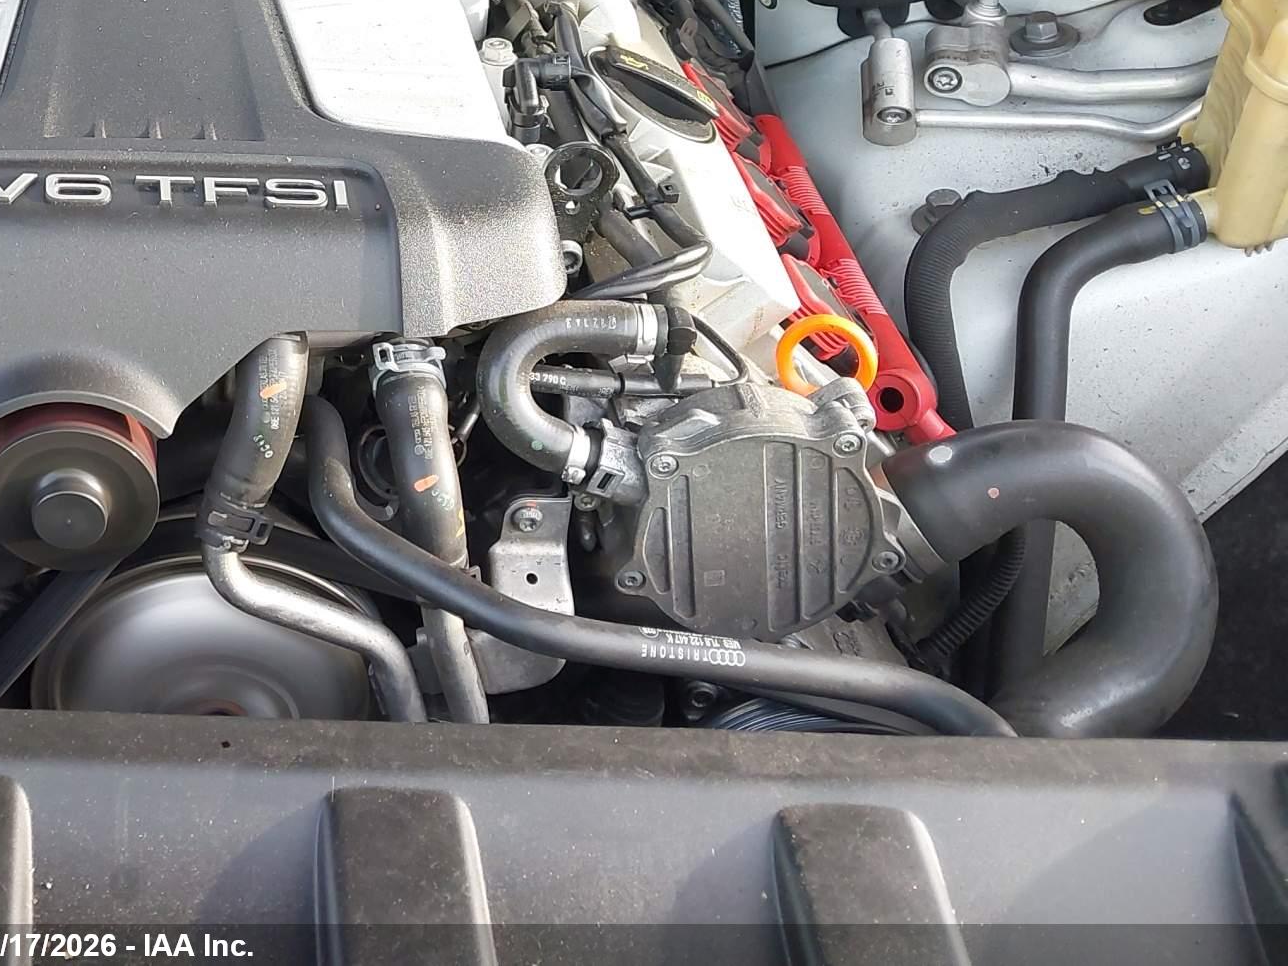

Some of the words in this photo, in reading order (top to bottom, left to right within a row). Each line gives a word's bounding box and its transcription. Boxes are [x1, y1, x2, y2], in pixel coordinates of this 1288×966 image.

[134, 174, 350, 210] TFSI
[774, 478, 787, 529] GERMANY
[641, 644, 709, 661] TRISTONE
